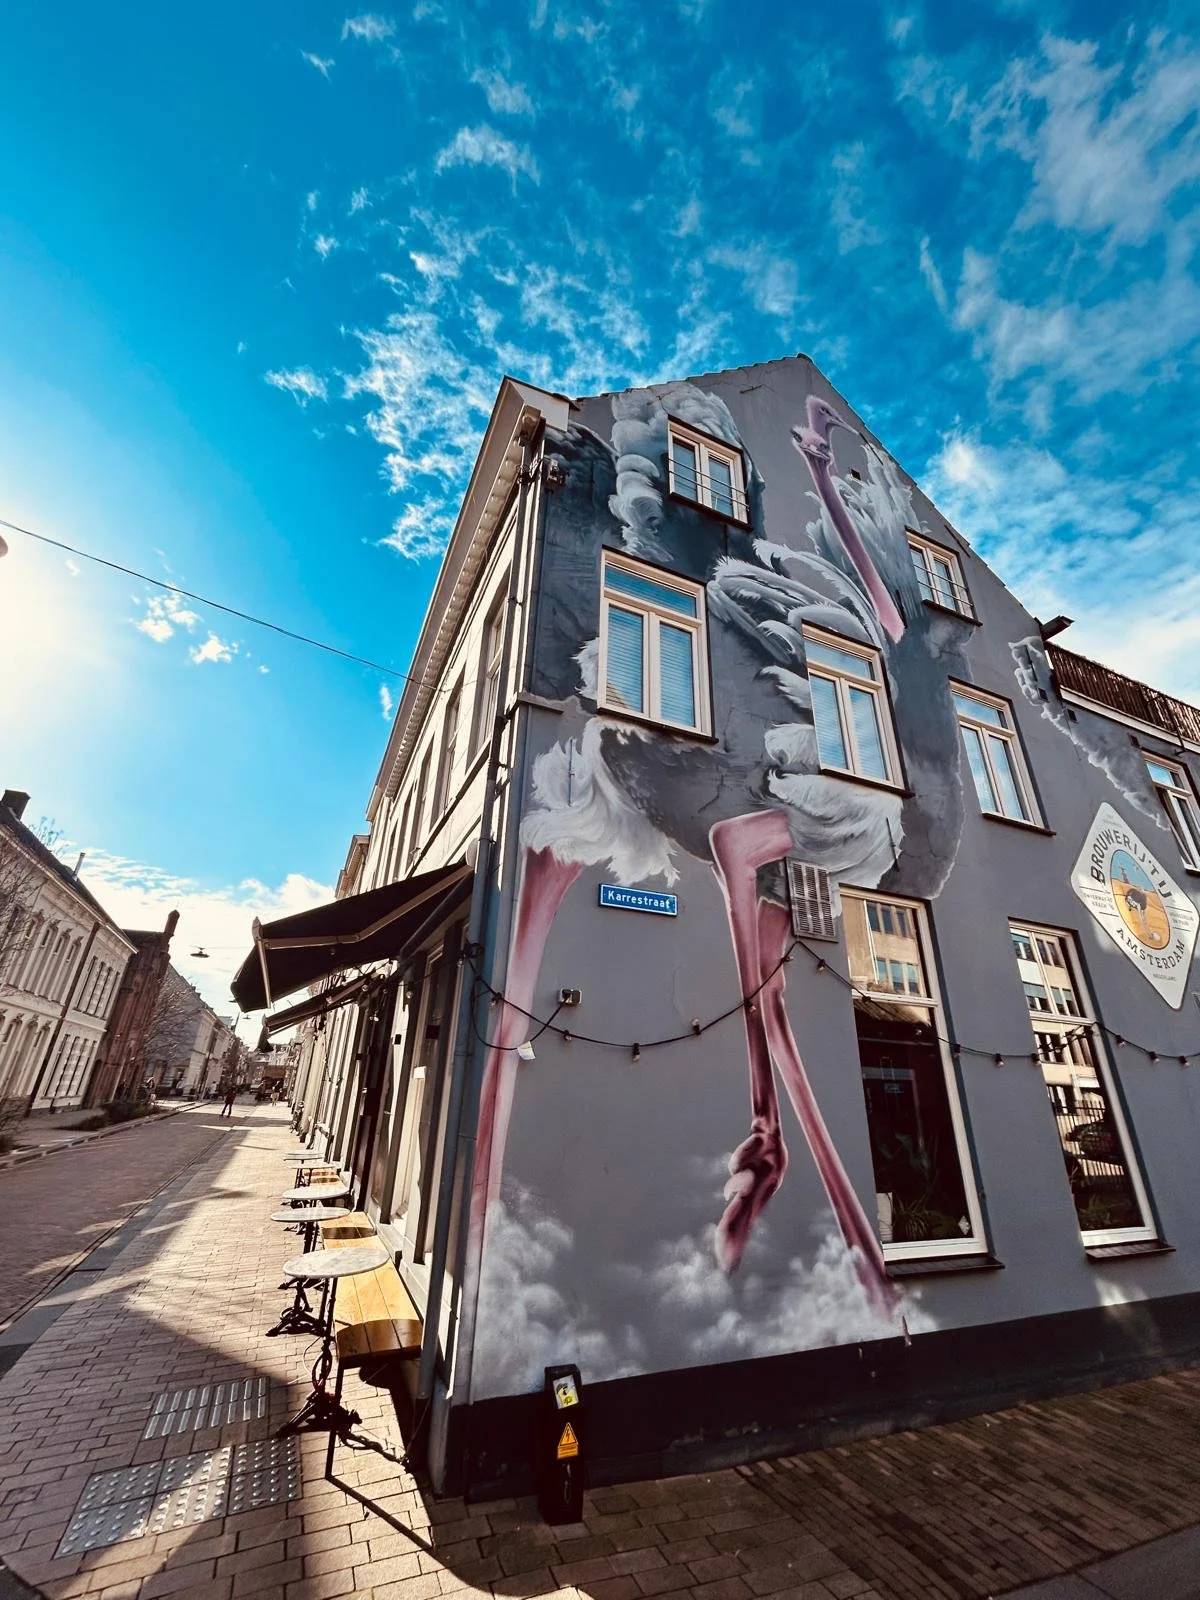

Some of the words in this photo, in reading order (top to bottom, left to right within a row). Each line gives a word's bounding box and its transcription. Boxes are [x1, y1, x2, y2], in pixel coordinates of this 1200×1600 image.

[1091, 829, 1146, 885] BROUWERIJ
[608, 890, 670, 909] Karrestraat
[1117, 928, 1185, 969] AMSTERDAM
